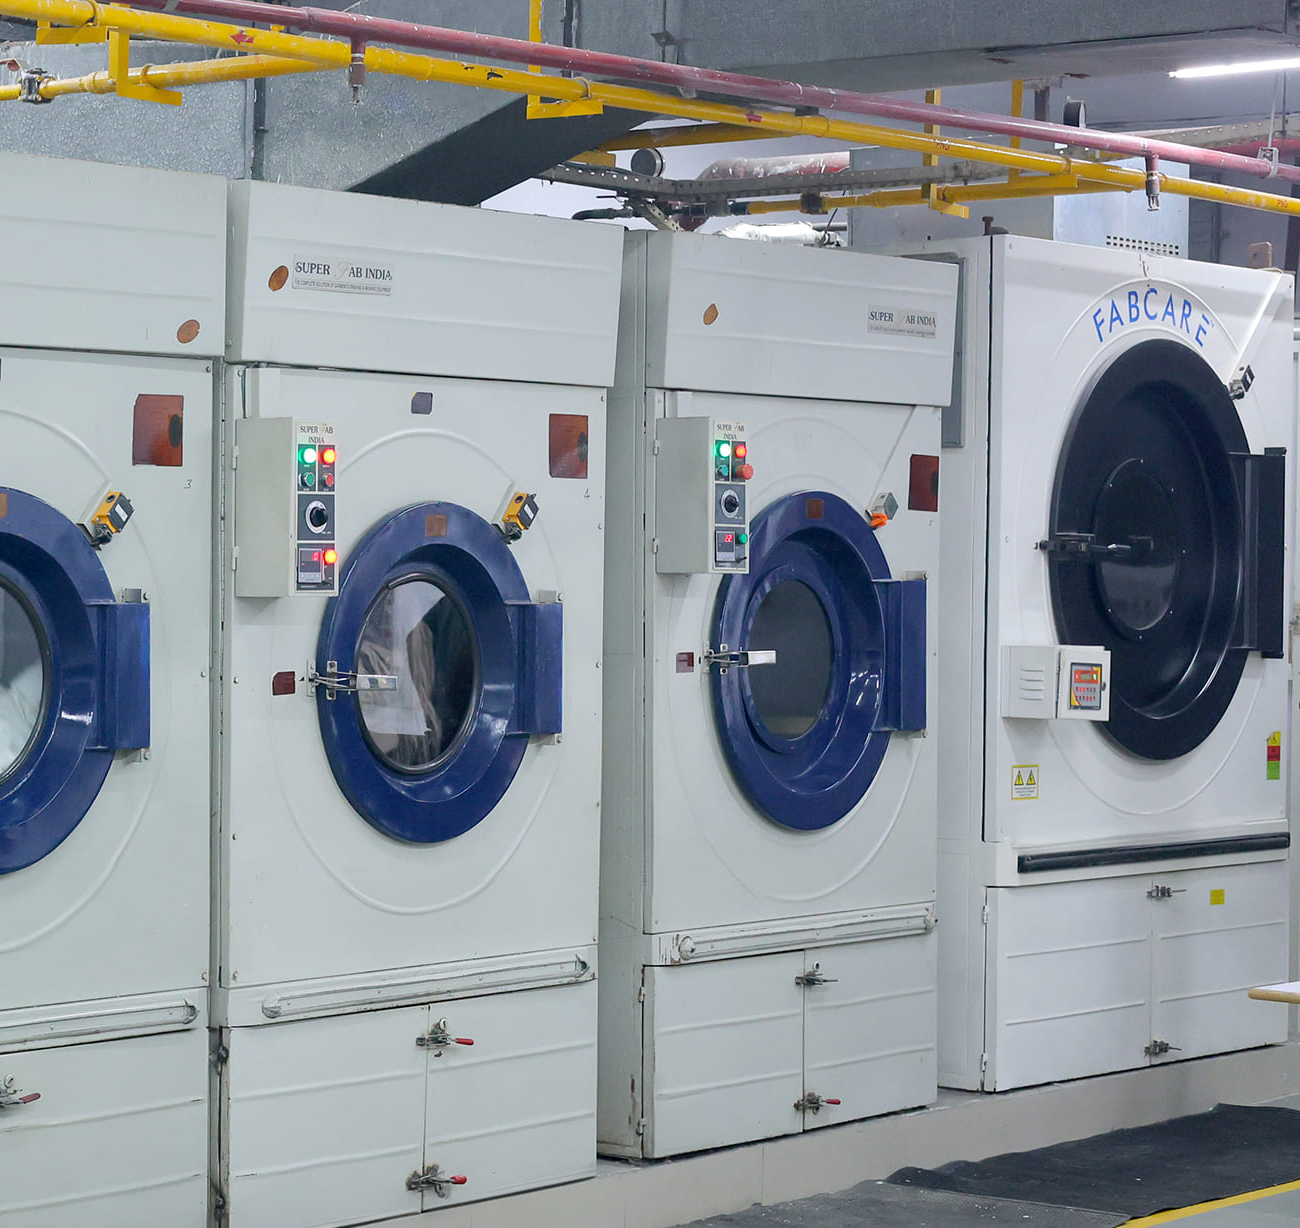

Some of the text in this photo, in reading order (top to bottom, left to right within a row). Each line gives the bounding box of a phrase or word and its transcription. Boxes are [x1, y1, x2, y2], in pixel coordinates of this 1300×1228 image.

[295, 261, 331, 275] SUPER
[365, 267, 392, 281] INDIA
[869, 310, 894, 323] SUPER
[916, 315, 937, 328] INDIA
[1092, 287, 1210, 348] FABCARE
[300, 425, 319, 434] SUPER
[308, 436, 325, 444] INDIA
